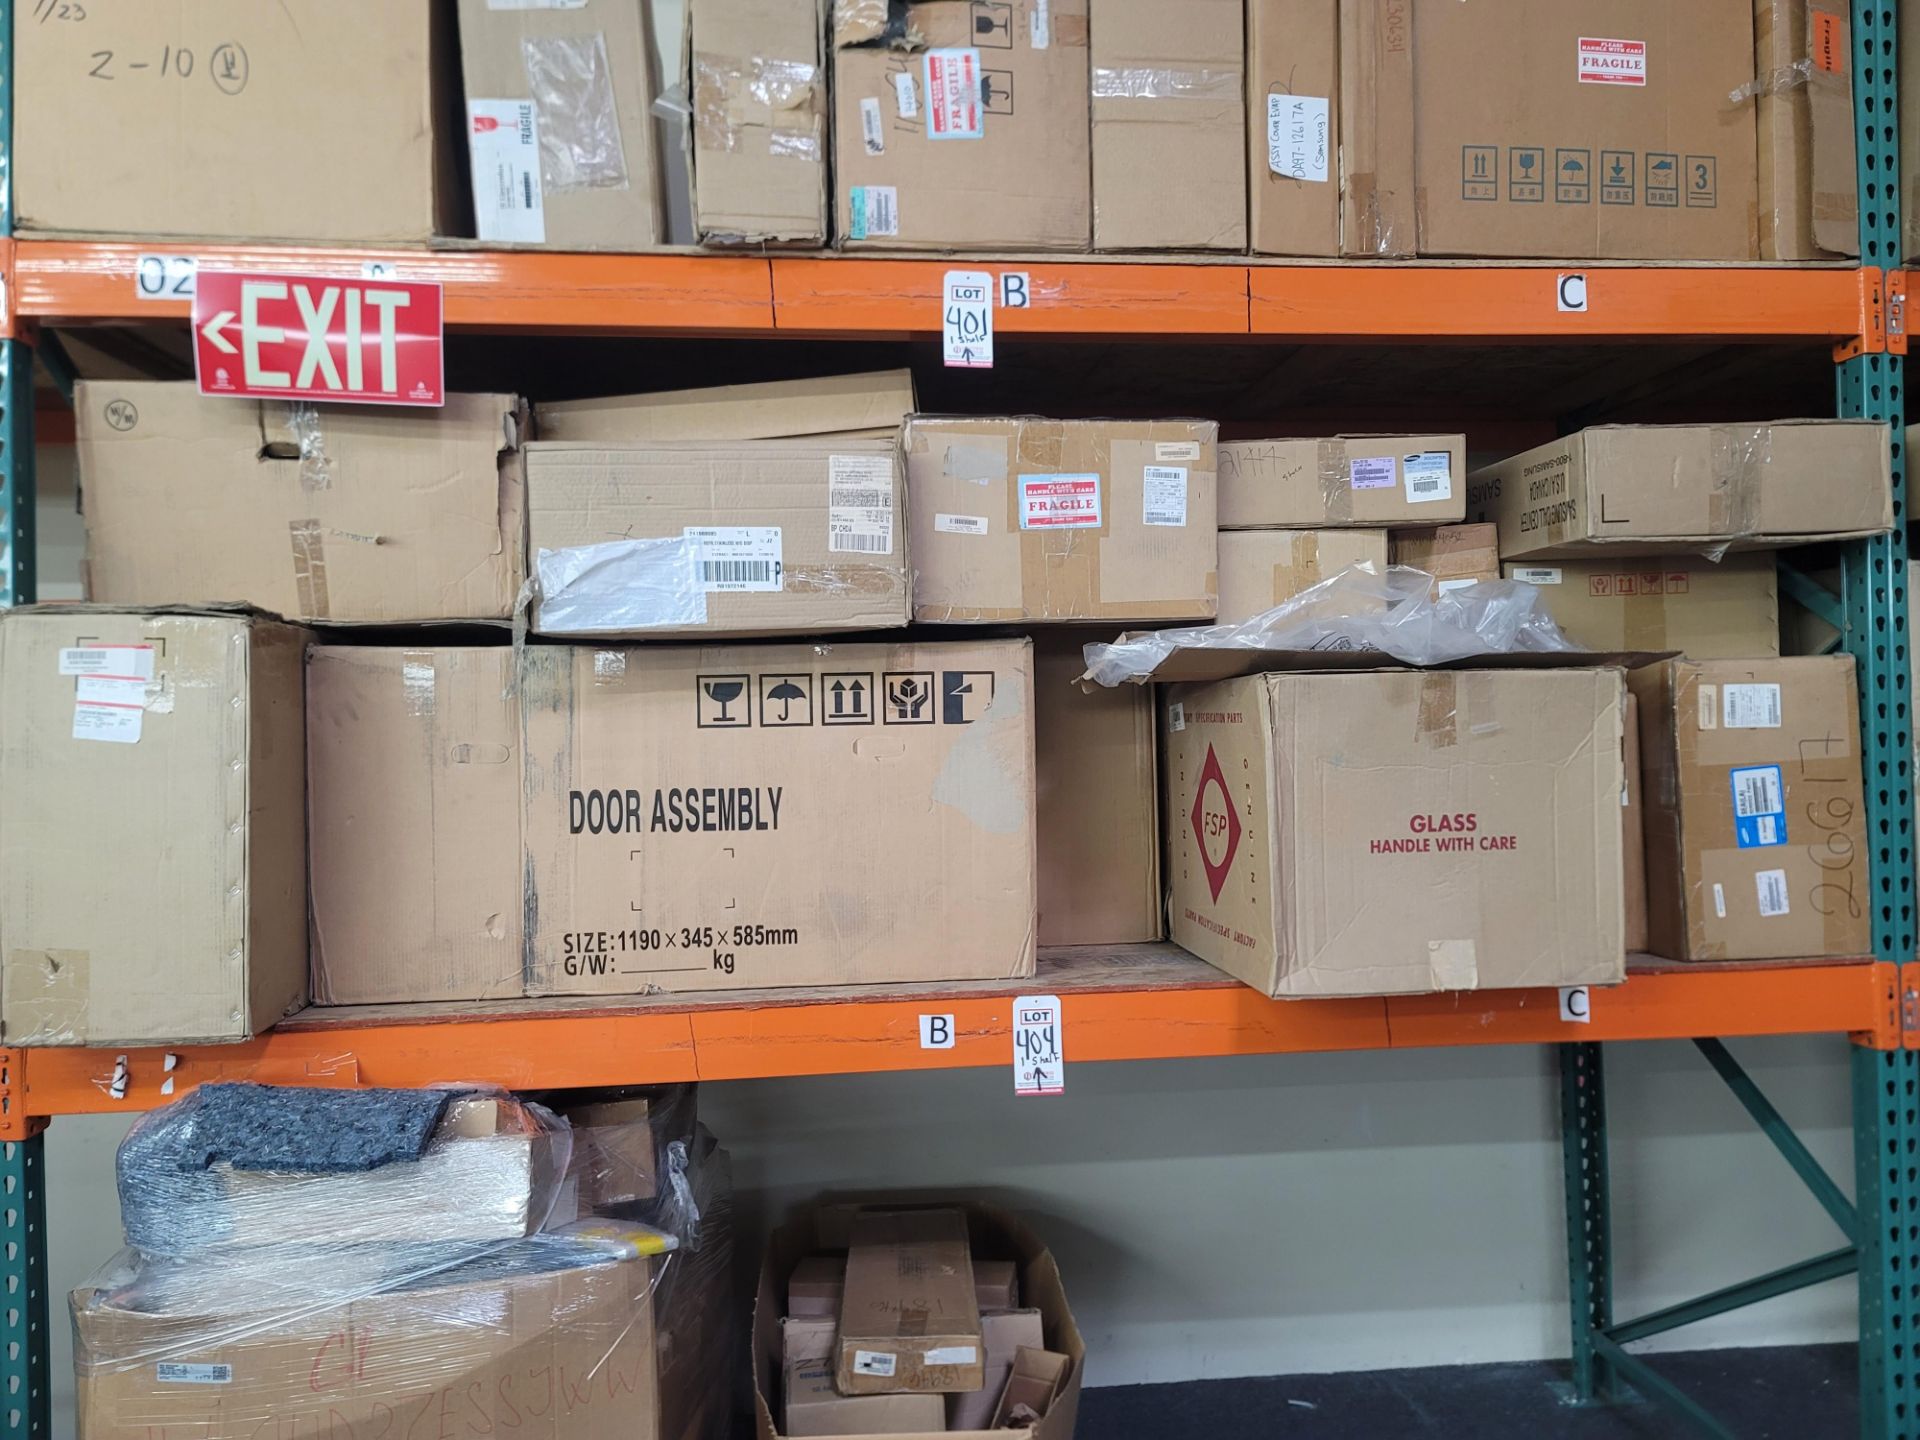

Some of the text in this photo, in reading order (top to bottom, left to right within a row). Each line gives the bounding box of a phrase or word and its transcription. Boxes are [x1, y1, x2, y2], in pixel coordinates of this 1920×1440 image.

[1581, 44, 1607, 52] HANDLE
[1624, 47, 1642, 55] CARE
[1582, 57, 1642, 70] FRAGILE
[947, 57, 962, 131] FRAGILE
[1270, 97, 1281, 119] EVAP
[519, 104, 533, 145] FRAGILE
[1271, 143, 1281, 168] ASSY
[1695, 164, 1708, 190] 3
[955, 289, 981, 299] LOT
[1004, 275, 1027, 307] B
[1560, 275, 1583, 308] C
[946, 305, 987, 338] 401
[241, 279, 411, 393] EXIT
[1029, 499, 1095, 512] FRAGILE
[1551, 499, 1577, 524] SAMSUNG
[775, 561, 781, 585] P
[1195, 712, 1226, 724] SPECIFICATION
[1227, 712, 1243, 724] PARTS
[569, 786, 783, 834] DOOR ASSEMBLY
[1204, 811, 1227, 838] FSP
[1409, 813, 1477, 833] GLASS
[1799, 730, 1861, 919] 26617
[1370, 835, 1517, 854] HANDLE WITH CARE
[1197, 914, 1230, 938] SPECIFICATION
[1233, 930, 1256, 949] FACTORY
[564, 949, 735, 976] G/W: kg
[1567, 990, 1587, 1016] C
[1024, 1012, 1050, 1022] LOT
[930, 1016, 949, 1044] B
[1016, 1025, 1055, 1060] 404
